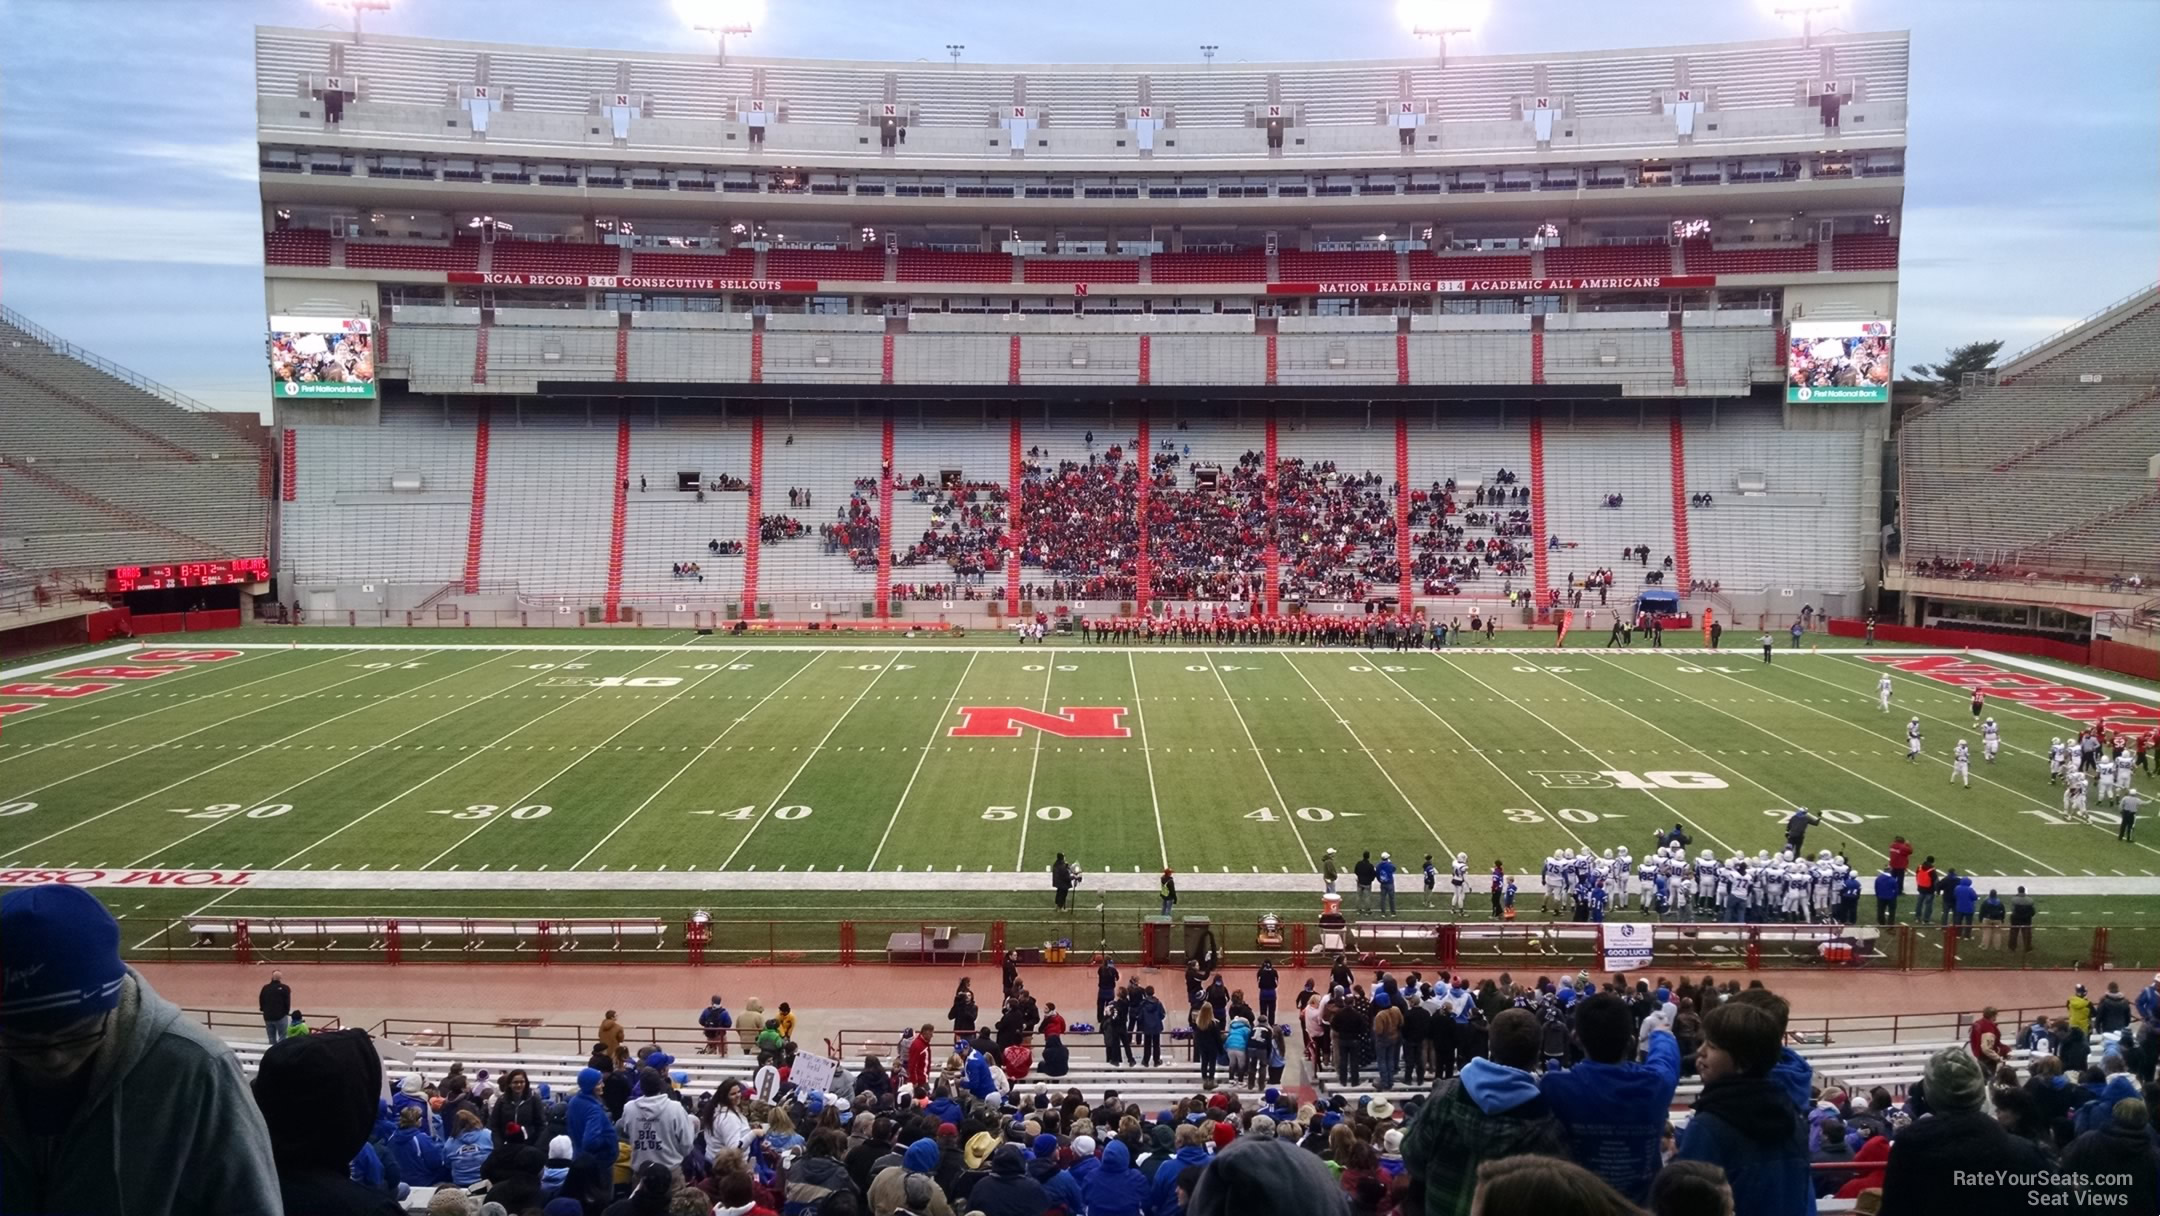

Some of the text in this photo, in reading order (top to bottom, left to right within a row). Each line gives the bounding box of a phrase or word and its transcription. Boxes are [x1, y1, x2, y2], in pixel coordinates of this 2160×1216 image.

[484, 274, 781, 290] NCAA RECORD 340 CONSECUTIVE SELLOUTS
[1319, 277, 1660, 293] NATION LEADING 314 ACADEMIC ALL AMERICANS
[1074, 283, 1088, 296] N
[301, 384, 365, 393] First National Bank
[181, 563, 207, 577] 8:37
[232, 559, 266, 571] BLUEJAYS
[119, 579, 134, 592] 34
[947, 706, 1132, 738] N
[184, 803, 294, 818] 20
[452, 804, 553, 820] 30
[719, 805, 813, 820] 40
[981, 805, 1073, 821] 50
[1243, 806, 1335, 822] 40
[1502, 808, 1599, 823] 30
[1548, 863, 1560, 874] 75
[112, 871, 256, 885] TOM
[638, 1130, 657, 1140] BIG
[634, 1140, 663, 1151] BLUE
